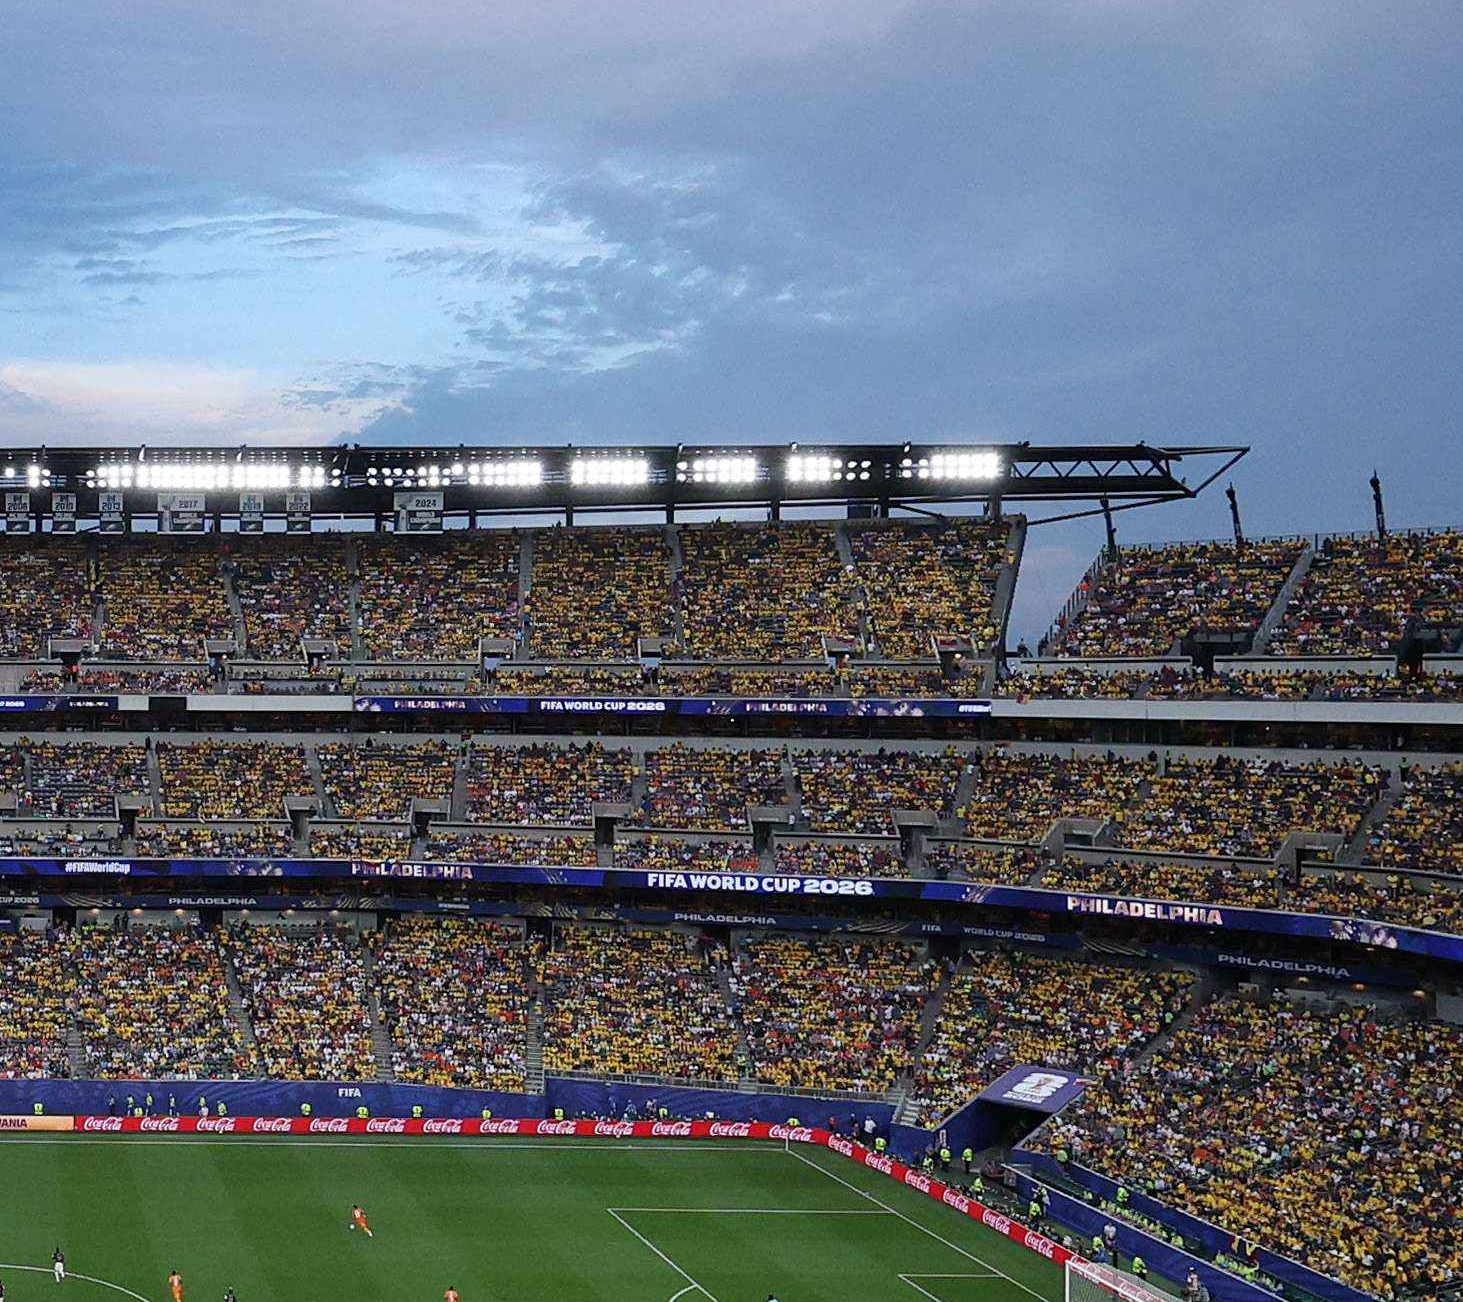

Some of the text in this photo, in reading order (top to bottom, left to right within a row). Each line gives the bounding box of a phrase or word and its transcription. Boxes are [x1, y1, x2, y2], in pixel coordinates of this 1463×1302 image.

[541, 701, 665, 711] FIFA WORLD CUP 2026
[65, 862, 131, 875] #FIFAWorldCup
[351, 862, 473, 879] PHILADELPHIA
[647, 873, 873, 896] FIFA WORLD CUP 2026
[168, 897, 257, 906] PHILADELPHIA
[1067, 896, 1222, 925] PHILADELPHIA
[674, 913, 776, 925] PHILADELPHIA
[1218, 954, 1351, 978] PHILADELPHIA
[337, 1087, 362, 1098] FIFA
